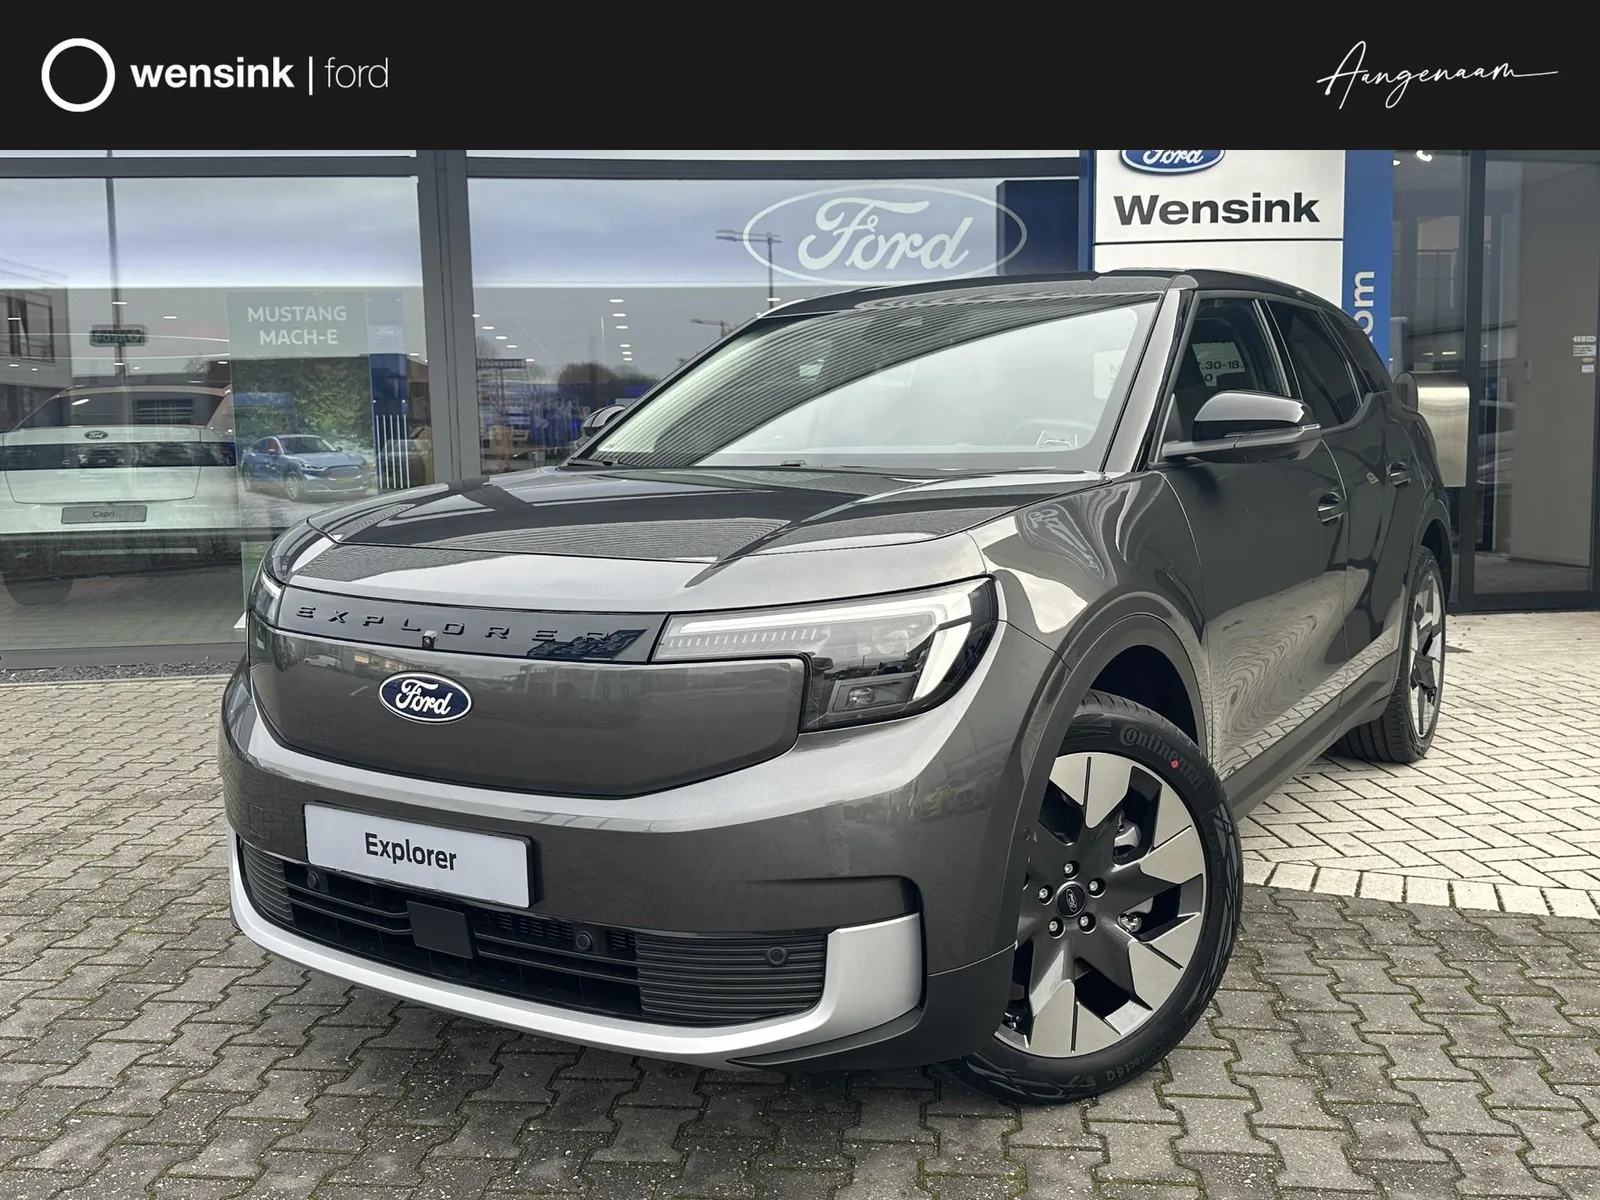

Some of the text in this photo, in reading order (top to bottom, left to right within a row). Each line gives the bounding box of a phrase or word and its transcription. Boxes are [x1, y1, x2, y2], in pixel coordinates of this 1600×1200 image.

[1113, 192, 1321, 226] Wensink
[798, 197, 974, 270] Ford
[247, 305, 347, 323] MUSTANG
[1353, 271, 1375, 344] om
[259, 329, 339, 346] MACH-E
[92, 510, 116, 518] Capri
[296, 606, 610, 644] EXPLORER
[395, 679, 453, 715] Ford
[365, 832, 457, 871] Explorer
